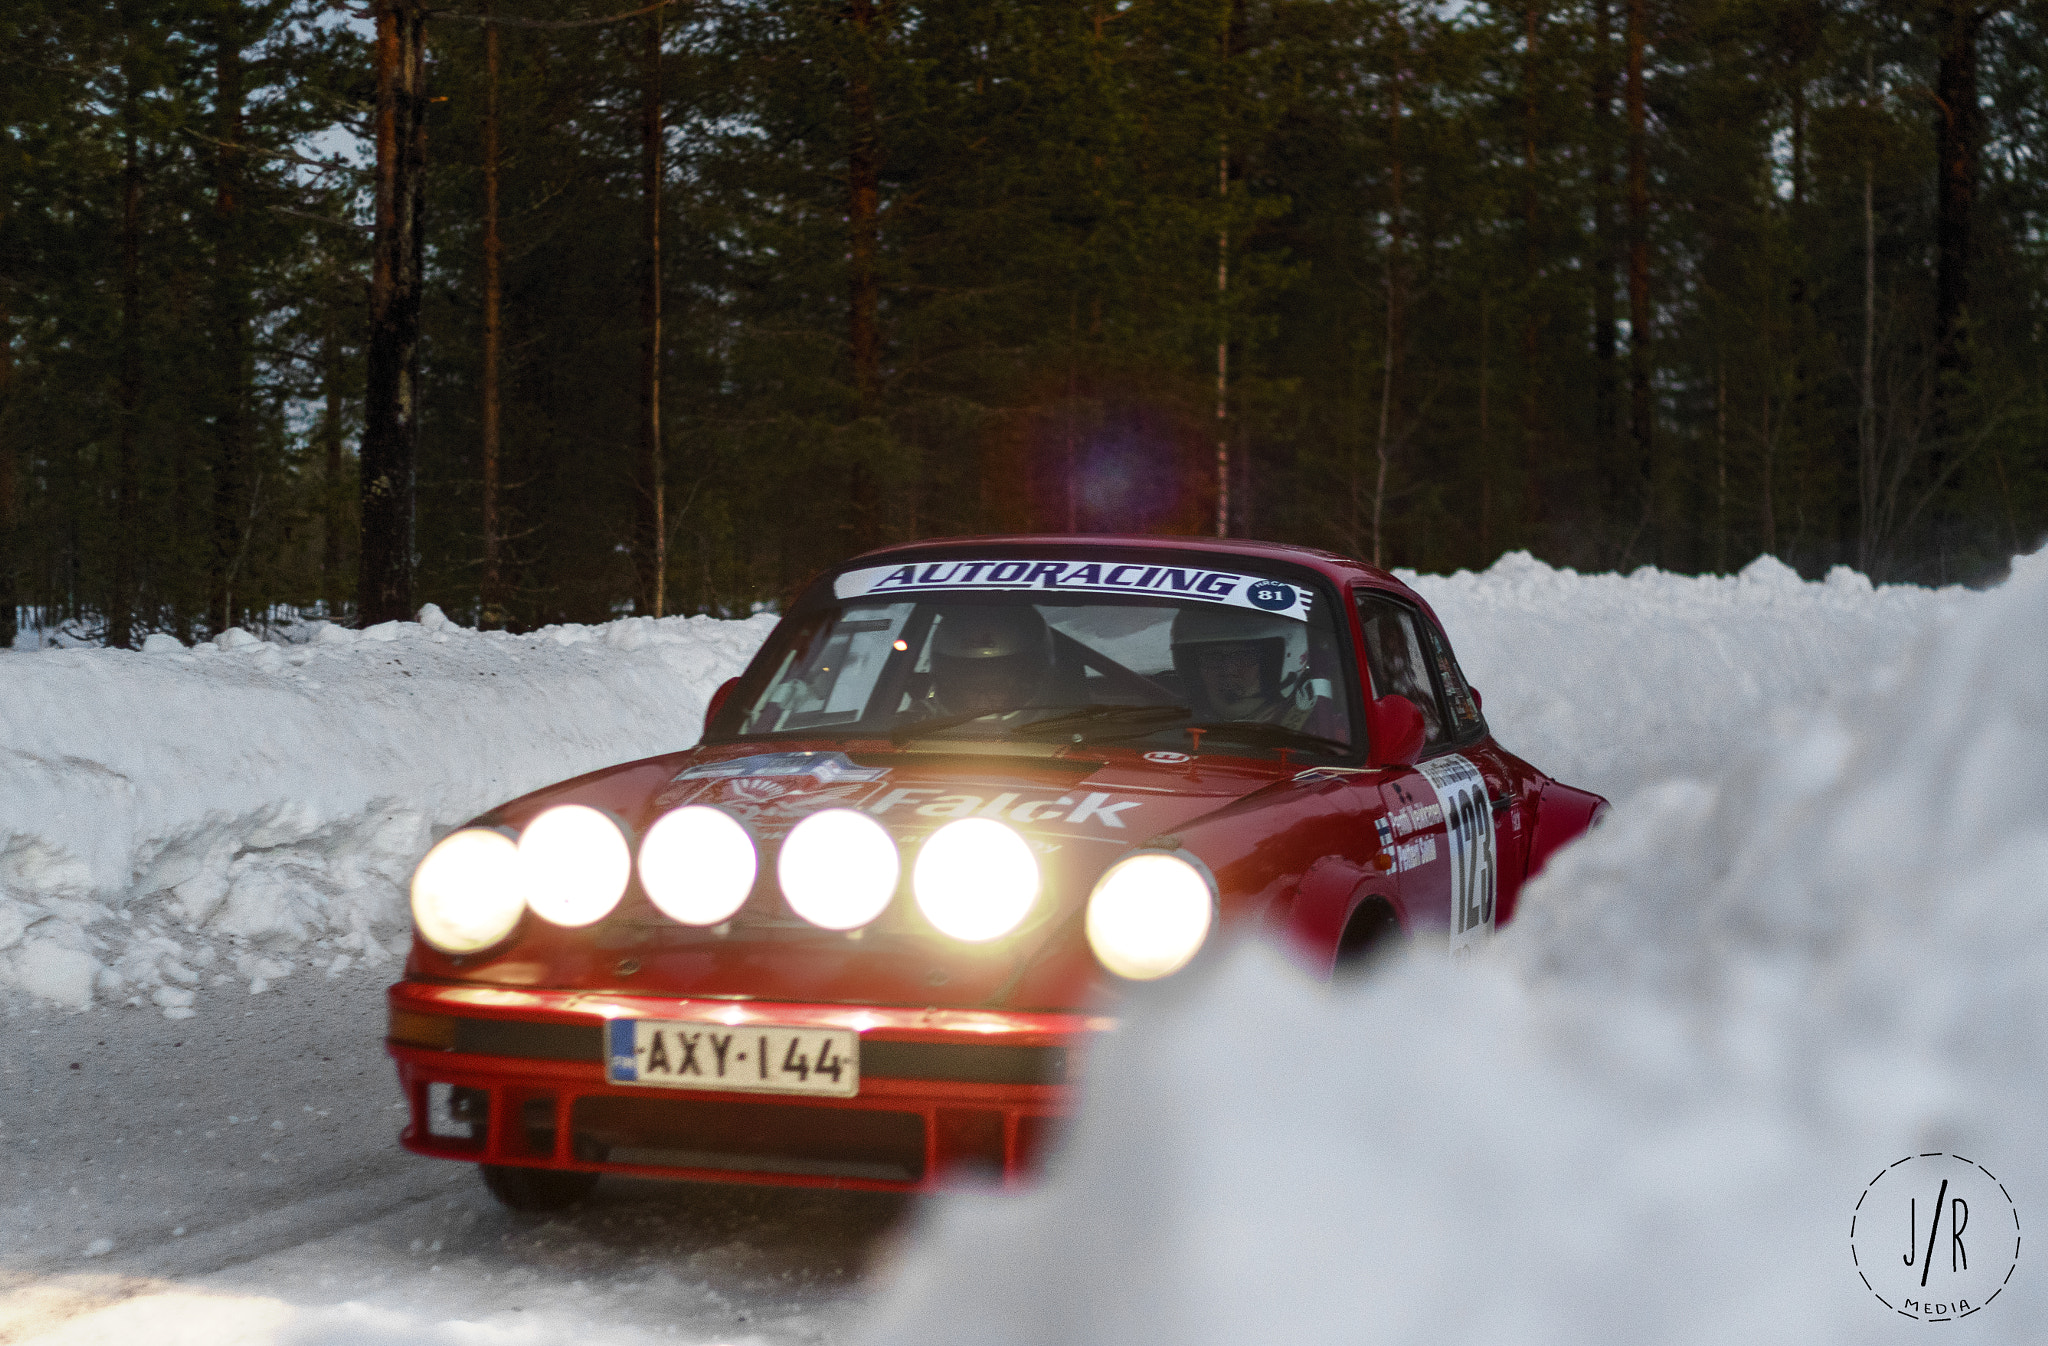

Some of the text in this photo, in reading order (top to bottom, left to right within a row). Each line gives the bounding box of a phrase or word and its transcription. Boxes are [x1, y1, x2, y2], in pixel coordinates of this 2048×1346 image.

[877, 561, 1241, 596] AUTORACING
[1257, 590, 1284, 601] 81
[868, 788, 1143, 828] Falck
[1449, 783, 1494, 935] 123
